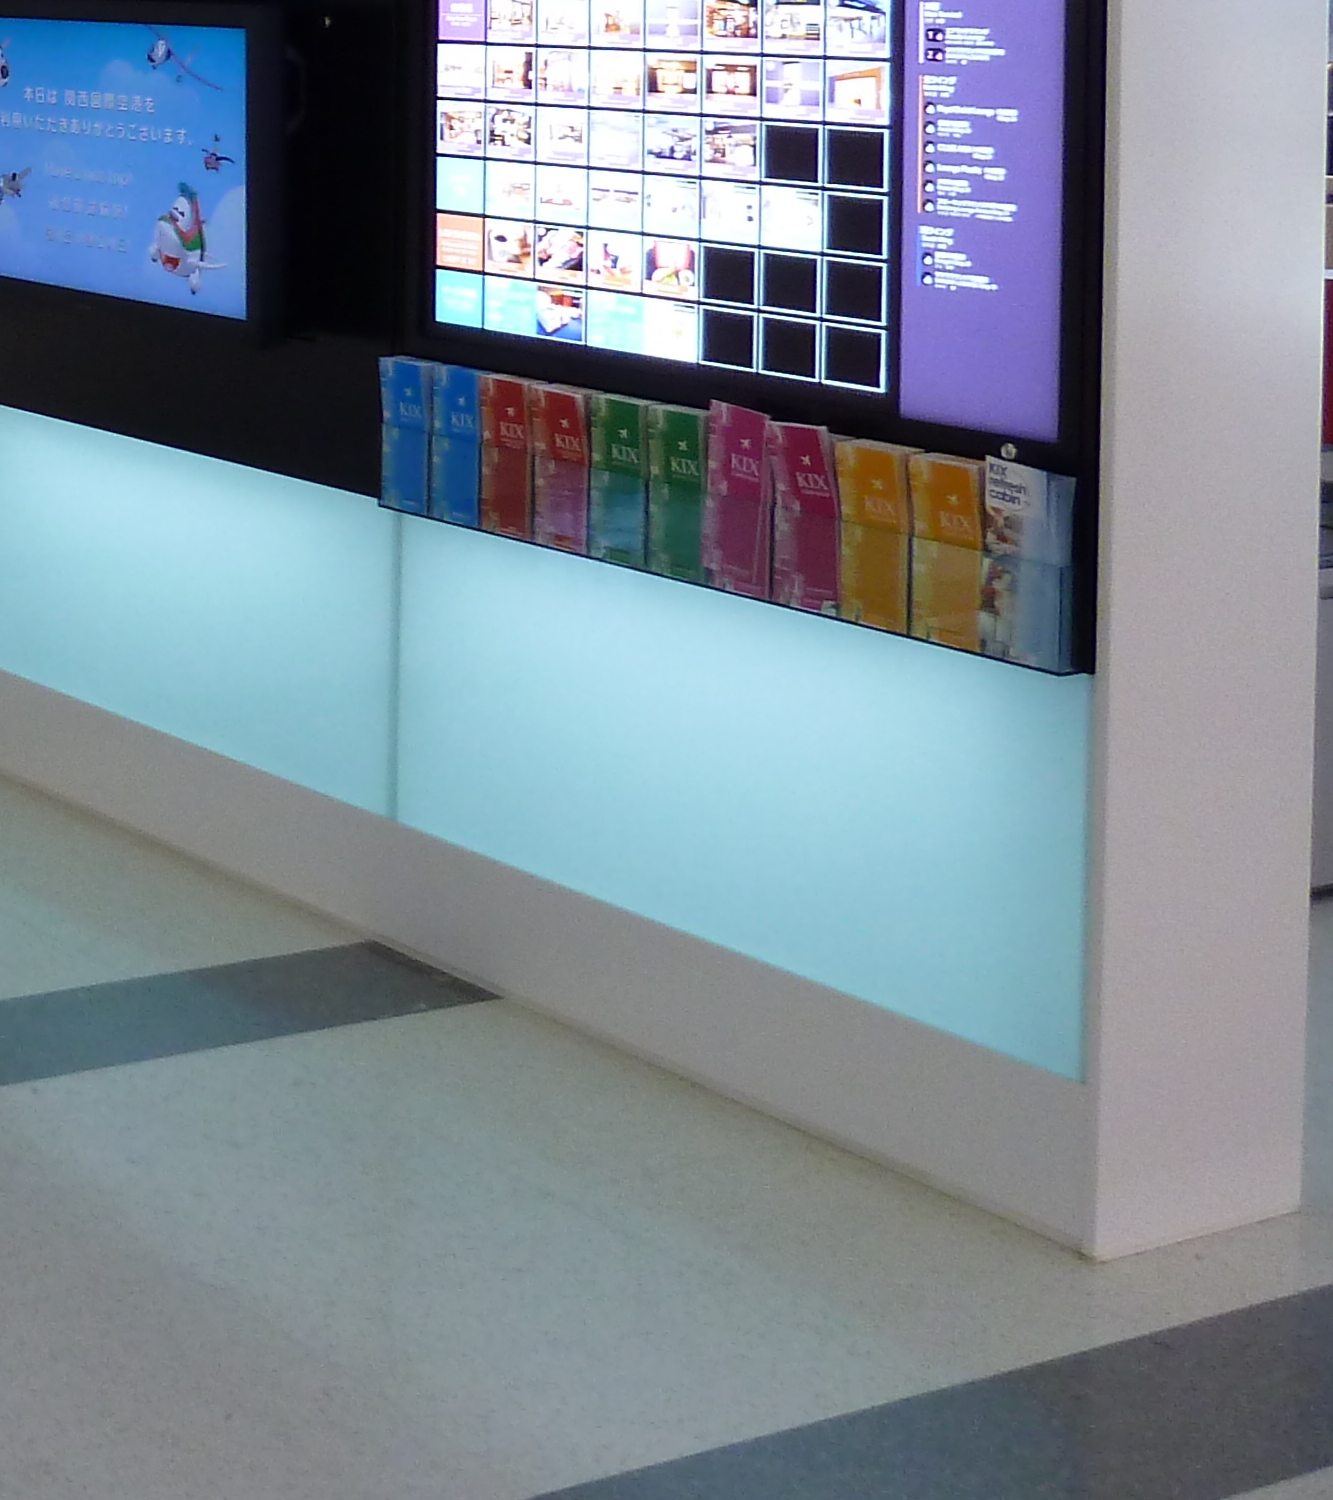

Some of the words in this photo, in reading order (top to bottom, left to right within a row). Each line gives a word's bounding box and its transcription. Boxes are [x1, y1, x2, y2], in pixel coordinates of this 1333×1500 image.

[399, 401, 423, 418] KIX
[451, 413, 475, 429] KIX
[500, 421, 525, 439] KIX
[555, 433, 582, 451] KIX
[611, 444, 639, 464] KIX
[671, 457, 699, 476] KIX
[730, 453, 759, 476] KIX
[796, 472, 828, 490] KIX
